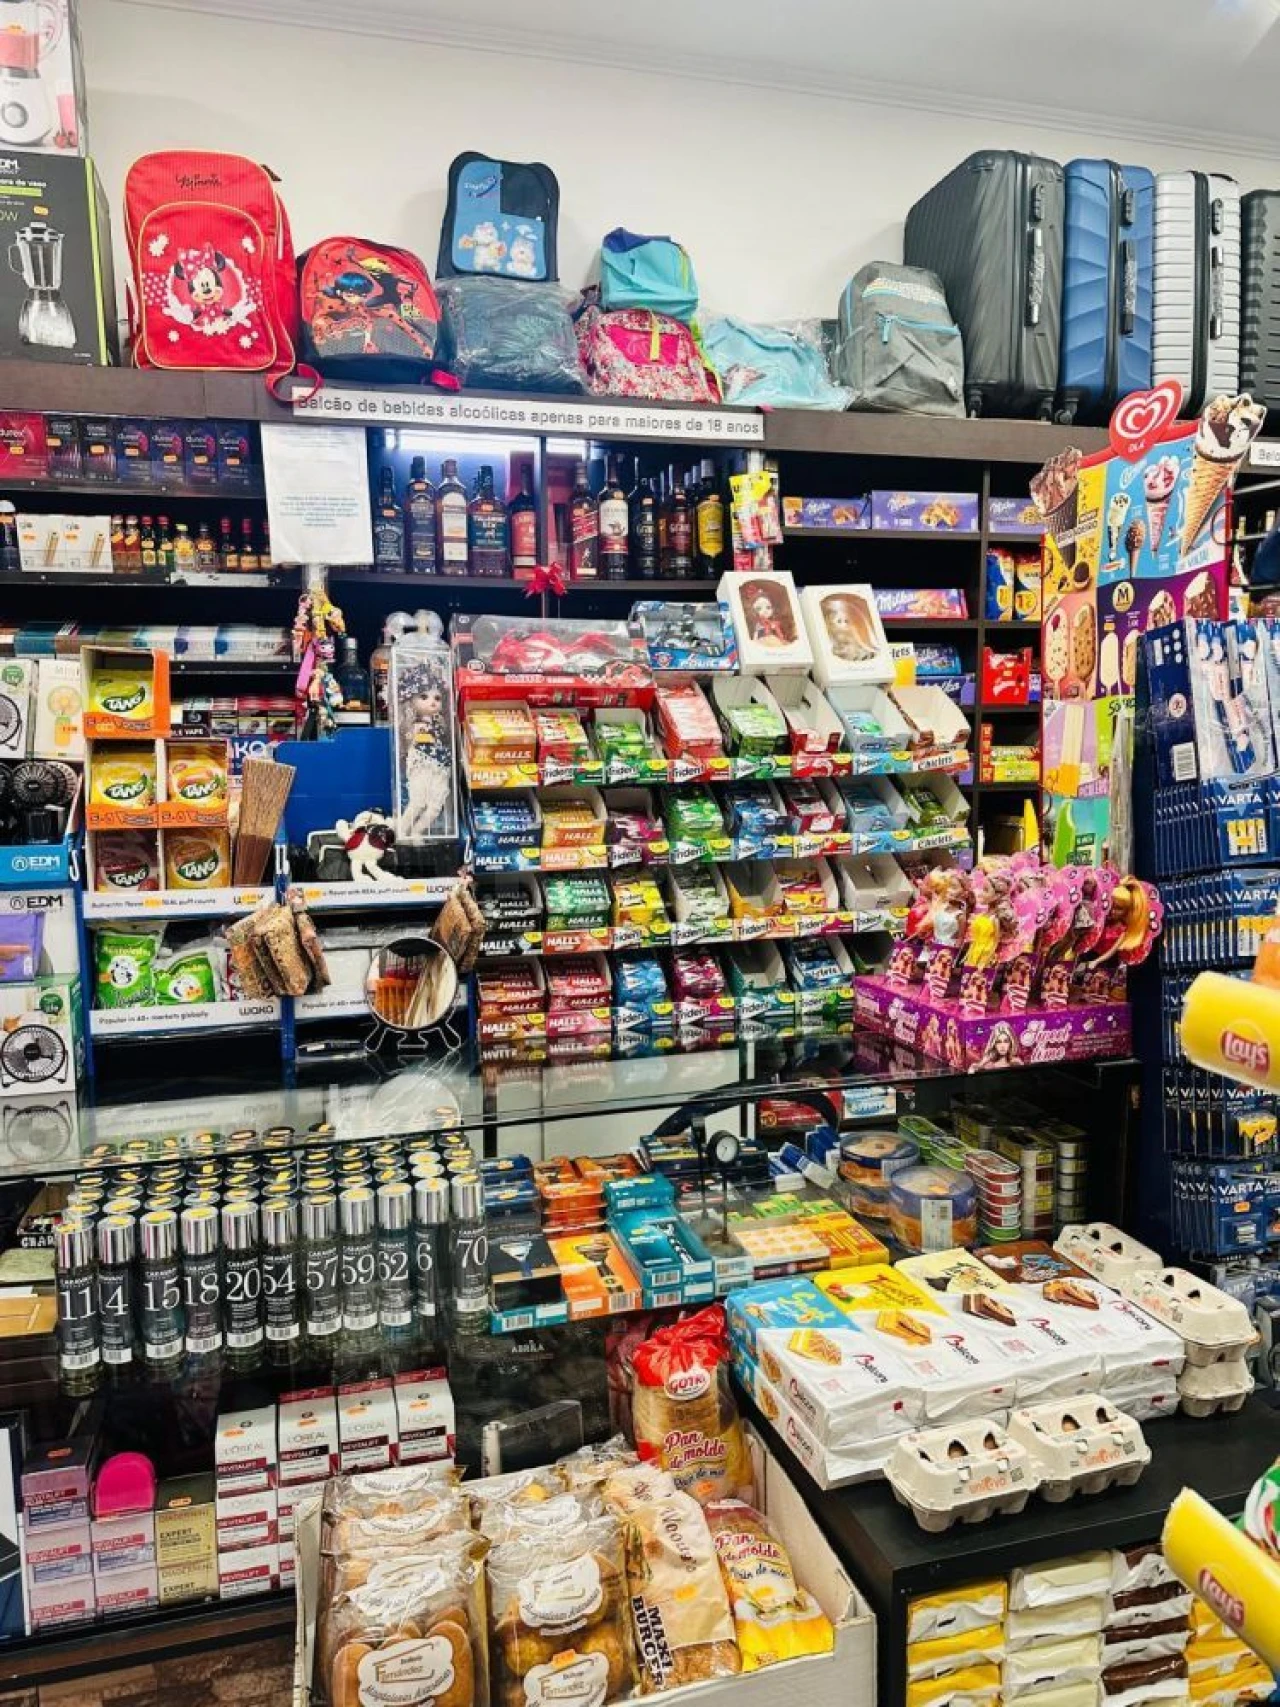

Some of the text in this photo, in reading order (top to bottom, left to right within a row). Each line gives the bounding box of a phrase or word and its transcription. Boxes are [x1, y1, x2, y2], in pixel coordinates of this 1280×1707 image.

[299, 396, 759, 433] Balcão de bebidas alcoólicas apenas para maiores de 18 anos
[106, 692, 142, 712] TANG
[494, 750, 532, 759] HALLS
[673, 764, 704, 776] Trident
[110, 782, 145, 799] TANG
[185, 782, 219, 799] TANG
[1219, 793, 1264, 804] VARTA
[497, 835, 535, 845] HALLS
[564, 831, 599, 841] HALLS
[610, 847, 642, 859] Trident
[29, 856, 61, 867] EDM
[475, 855, 513, 866] HALLS
[179, 859, 217, 880] TANG
[107, 870, 148, 887] TANG
[26, 894, 63, 909] EDM
[1233, 889, 1279, 901] VARTA
[499, 920, 535, 930] HALLS
[568, 916, 603, 926] HALLS
[737, 924, 770, 936] Trident
[480, 939, 516, 951] HALLS
[547, 936, 581, 946] HALLS
[572, 976, 602, 986] HALLS
[502, 1003, 539, 1012] HALLS
[570, 997, 606, 1006] HALLS
[738, 1001, 771, 1013] Trident
[679, 1006, 710, 1019] Trident
[99, 1017, 127, 1026] Popular
[482, 1023, 518, 1034] HALLS
[549, 1018, 581, 1028] HALLS
[1224, 1032, 1269, 1071] Lay's
[1219, 1181, 1264, 1196] VARTA
[457, 1235, 488, 1269] 70
[306, 1256, 338, 1290] 57
[342, 1253, 375, 1285] 59
[378, 1250, 409, 1282] 62
[226, 1267, 262, 1301] 20
[262, 1263, 296, 1295] 54
[144, 1276, 180, 1312] 15
[183, 1272, 220, 1306] 18
[60, 1286, 97, 1321] 11
[665, 1431, 700, 1453] Pan
[669, 1440, 726, 1469] de molde
[159, 1527, 192, 1539] EXPERT
[738, 1543, 781, 1559] molde
[632, 1595, 665, 1687] BURGER
[648, 1605, 674, 1668] MAXI
